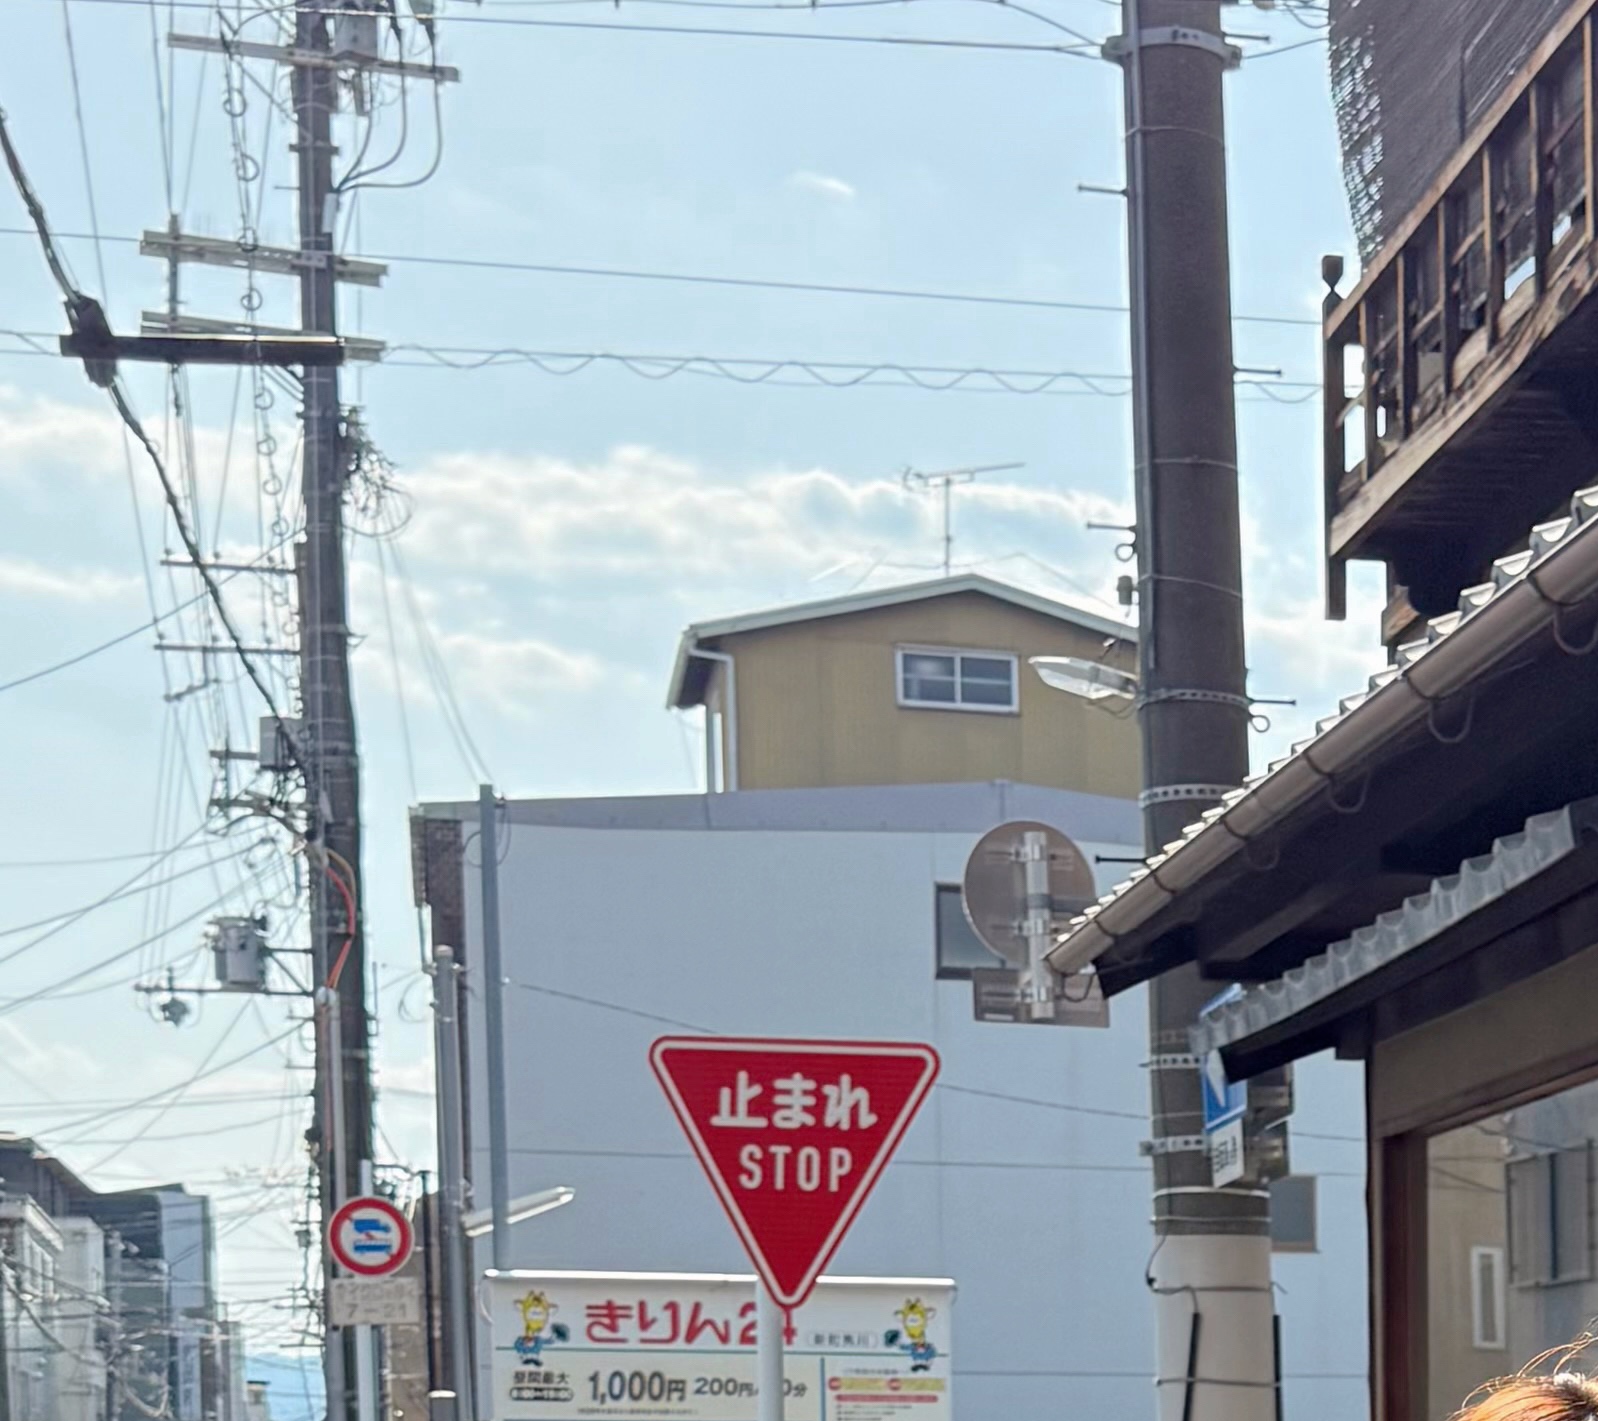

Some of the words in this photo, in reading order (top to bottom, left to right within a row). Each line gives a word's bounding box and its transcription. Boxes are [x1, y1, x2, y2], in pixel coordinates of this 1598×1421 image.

[710, 1070, 878, 1131] 止まれ
[739, 1144, 853, 1192] STOP
